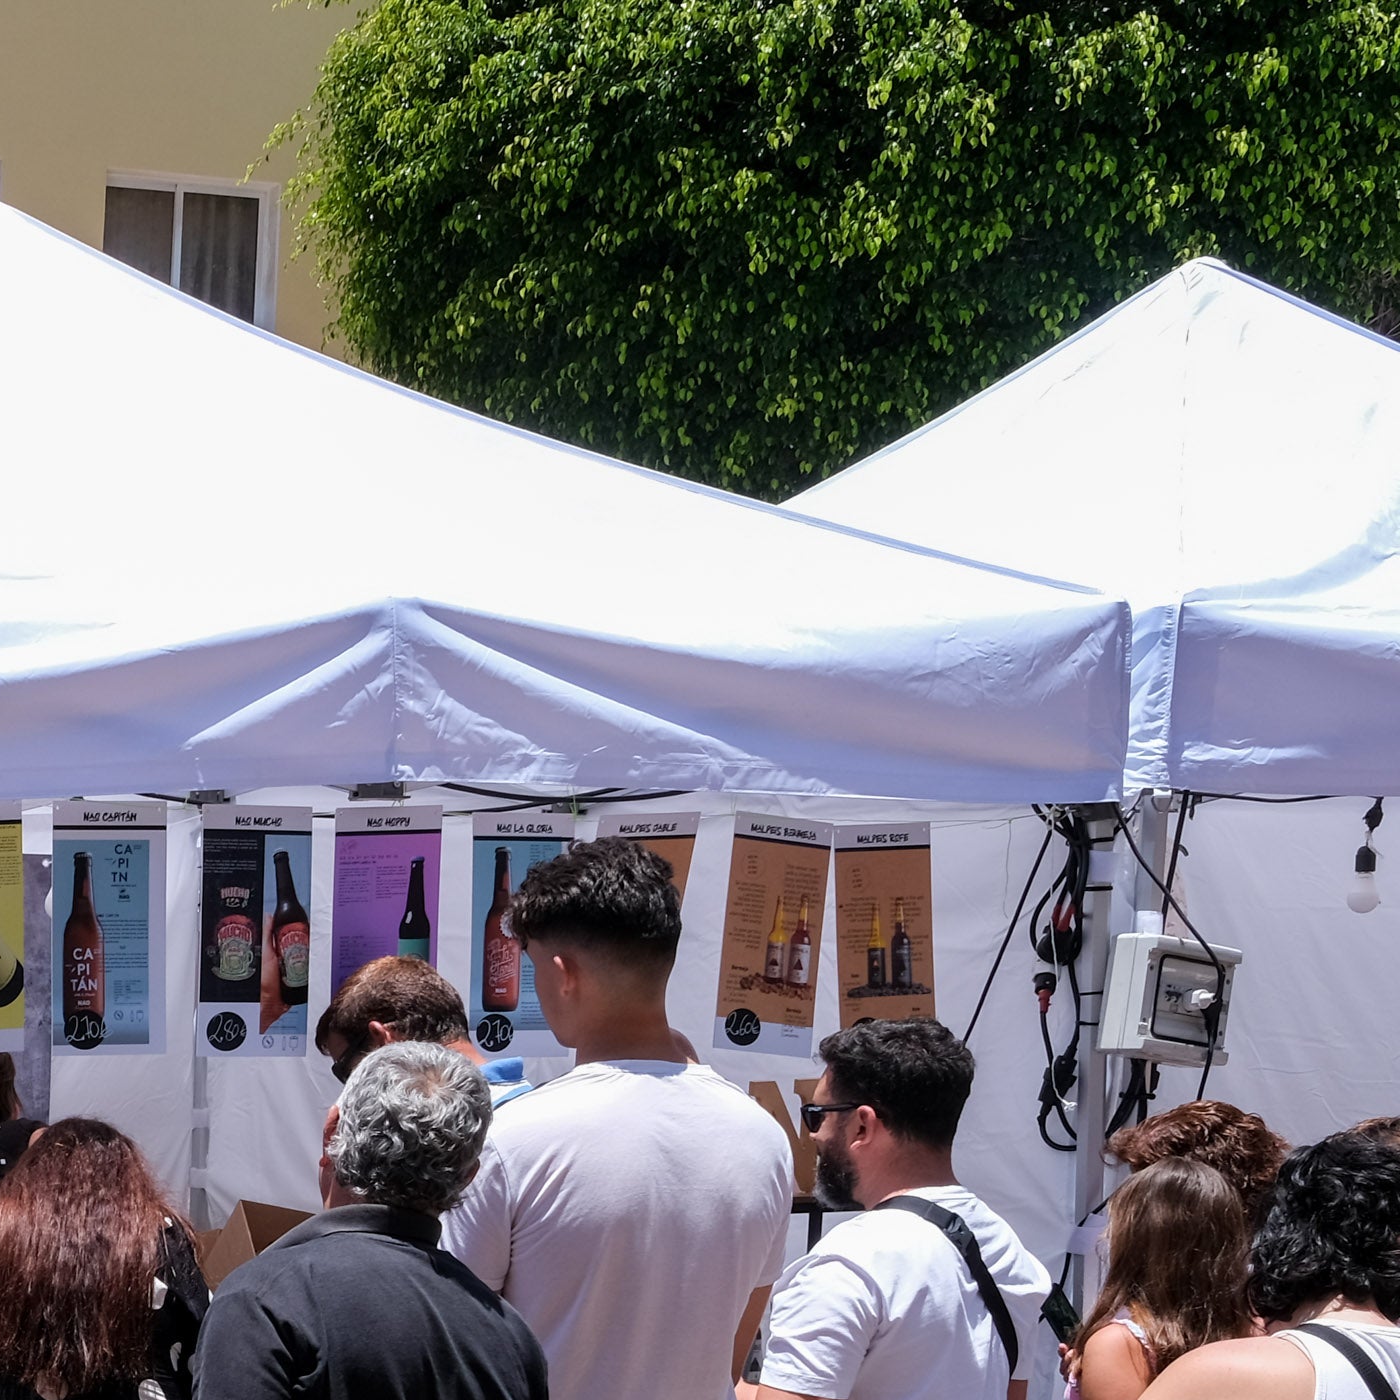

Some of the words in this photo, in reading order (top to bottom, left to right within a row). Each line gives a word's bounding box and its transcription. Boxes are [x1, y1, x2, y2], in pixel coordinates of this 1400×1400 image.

[254, 817, 282, 826] MUCHO
[73, 948, 94, 960] CA
[77, 964, 90, 976] PI
[70, 976, 98, 992] TÁN
